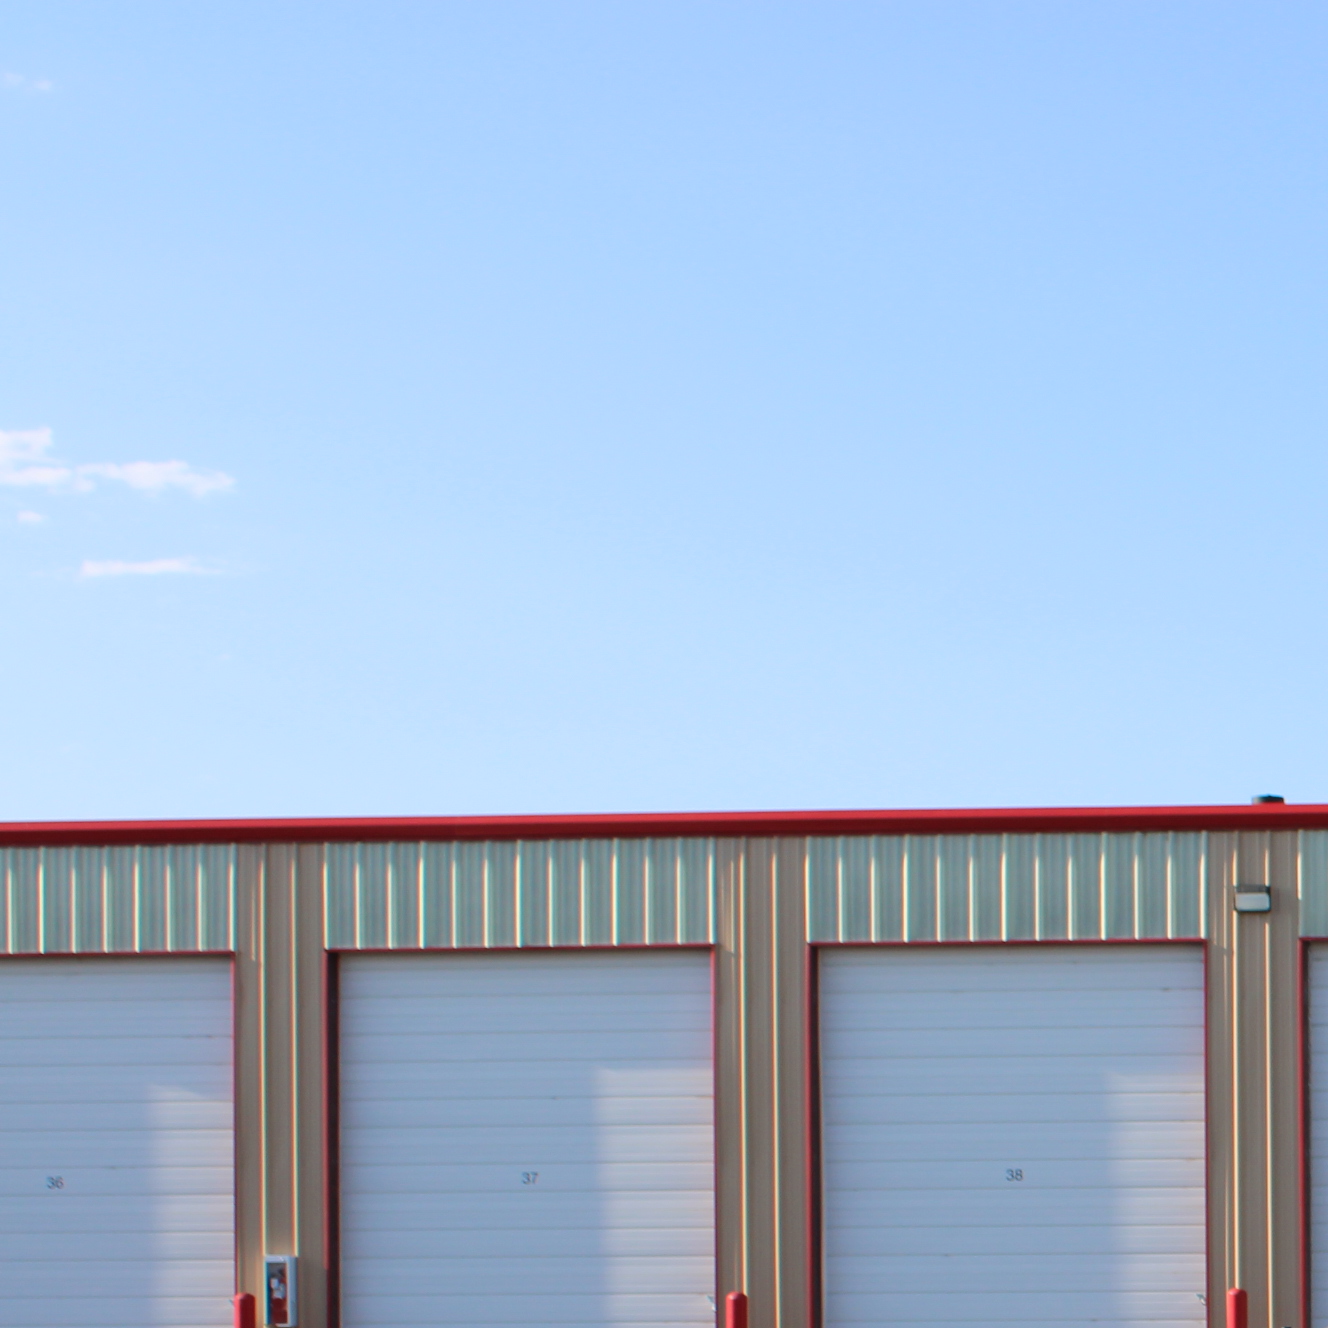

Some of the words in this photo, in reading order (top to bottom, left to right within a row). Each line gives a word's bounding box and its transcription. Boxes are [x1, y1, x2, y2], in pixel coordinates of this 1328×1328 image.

[522, 1171, 540, 1185] 37
[1005, 1168, 1024, 1182] 38
[46, 1175, 65, 1190] 36
